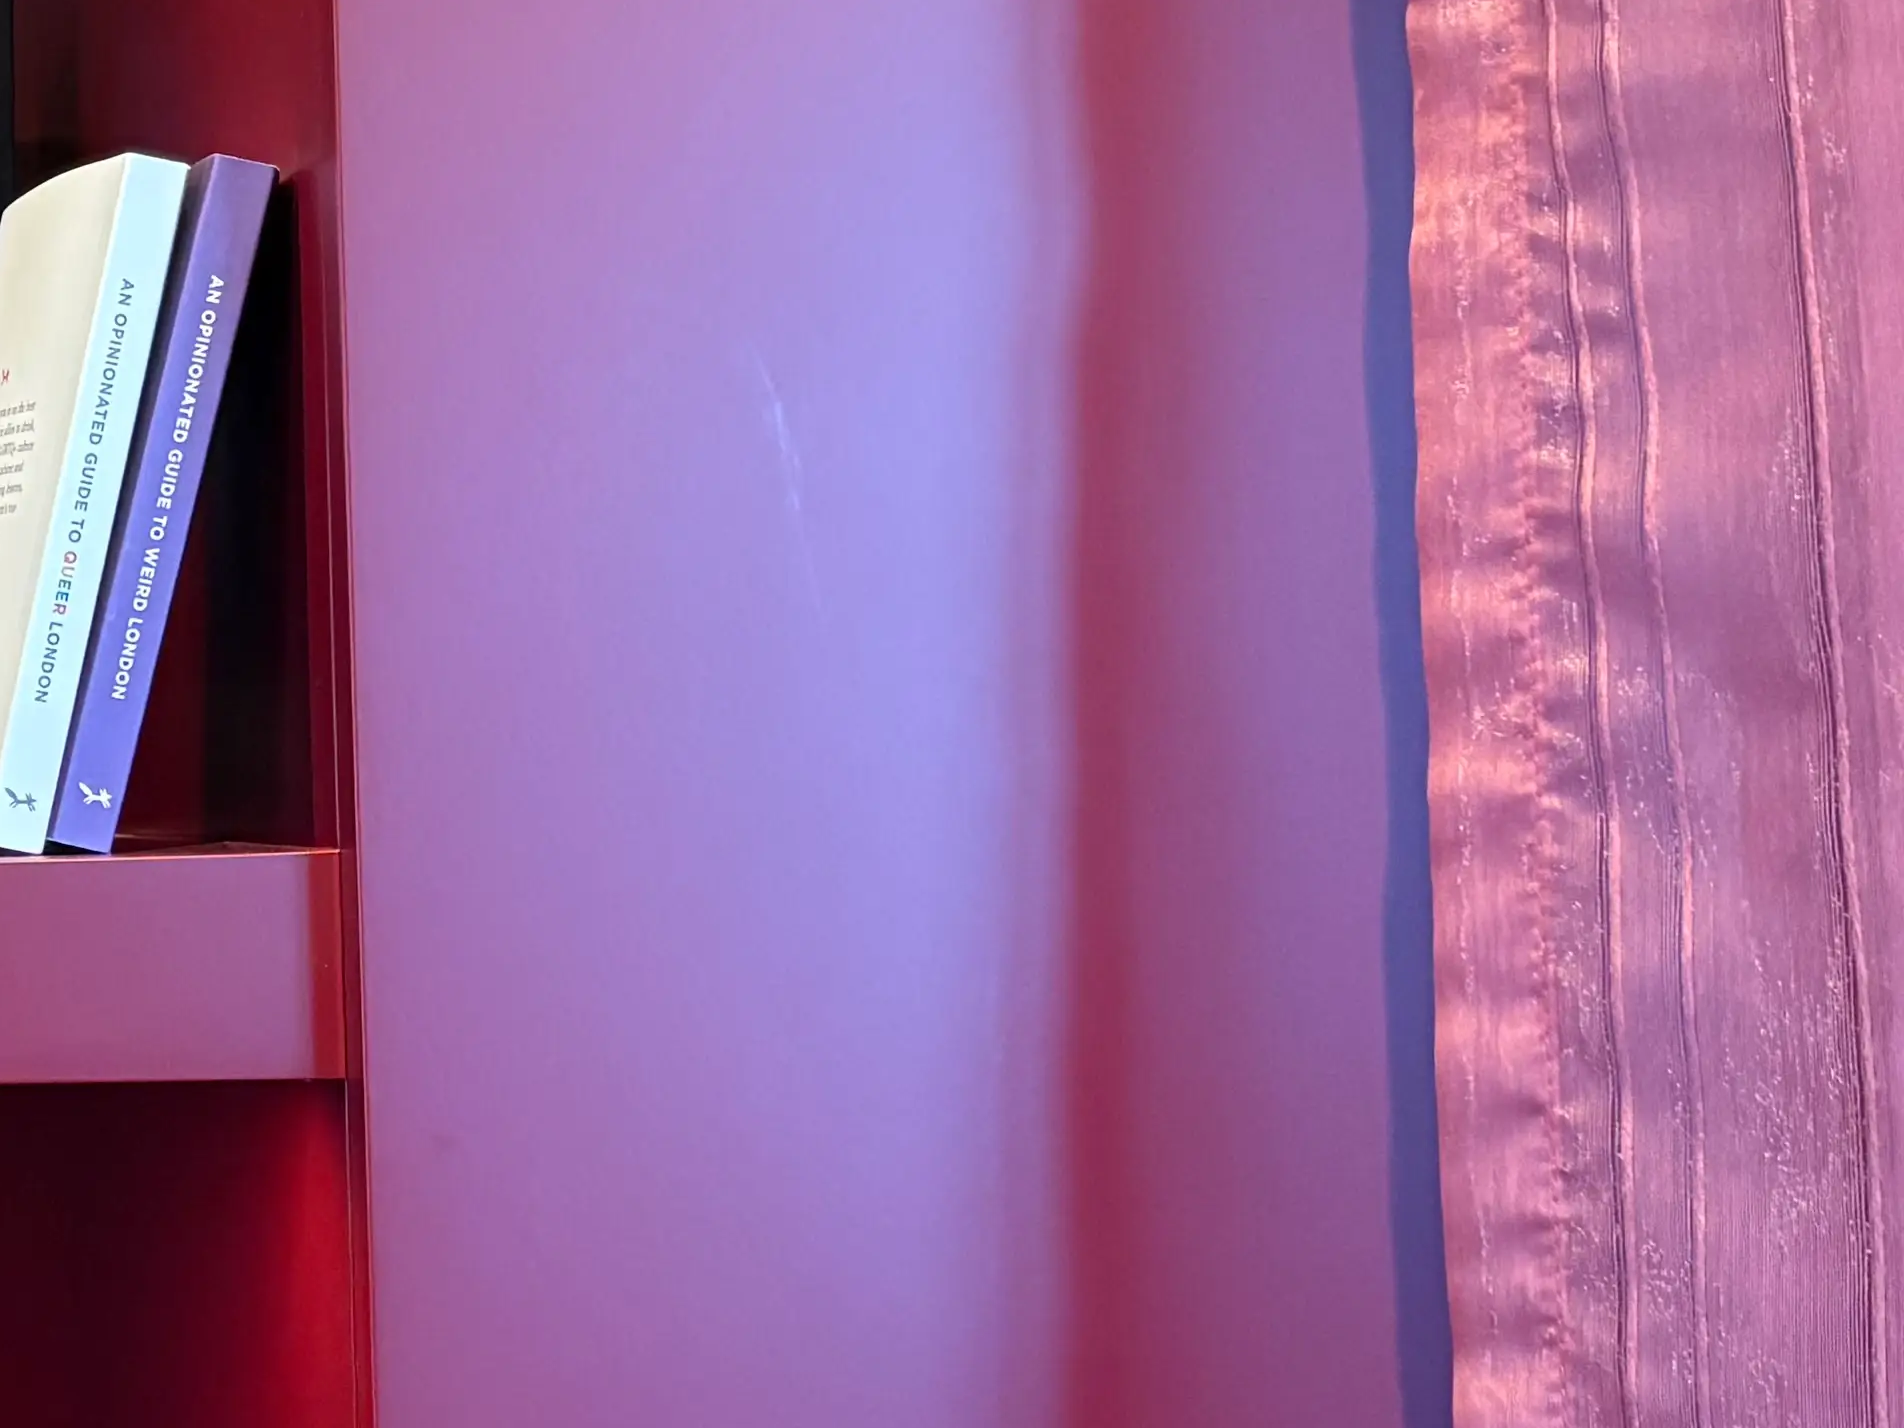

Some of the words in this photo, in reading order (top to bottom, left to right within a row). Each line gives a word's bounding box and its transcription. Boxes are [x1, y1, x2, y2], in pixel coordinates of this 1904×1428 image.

[118, 277, 135, 306] AN
[205, 274, 225, 304] AN
[89, 313, 128, 445] OPINIONATED
[173, 310, 217, 443] OPINIONATED
[74, 452, 98, 512] GUIDE
[156, 449, 183, 510] GUIDE
[68, 519, 85, 543] TO
[149, 515, 168, 541] TO
[52, 551, 78, 615] QUEER
[132, 547, 160, 612] WEIRD
[34, 621, 63, 703] LONDON
[111, 616, 143, 700] LONDON
